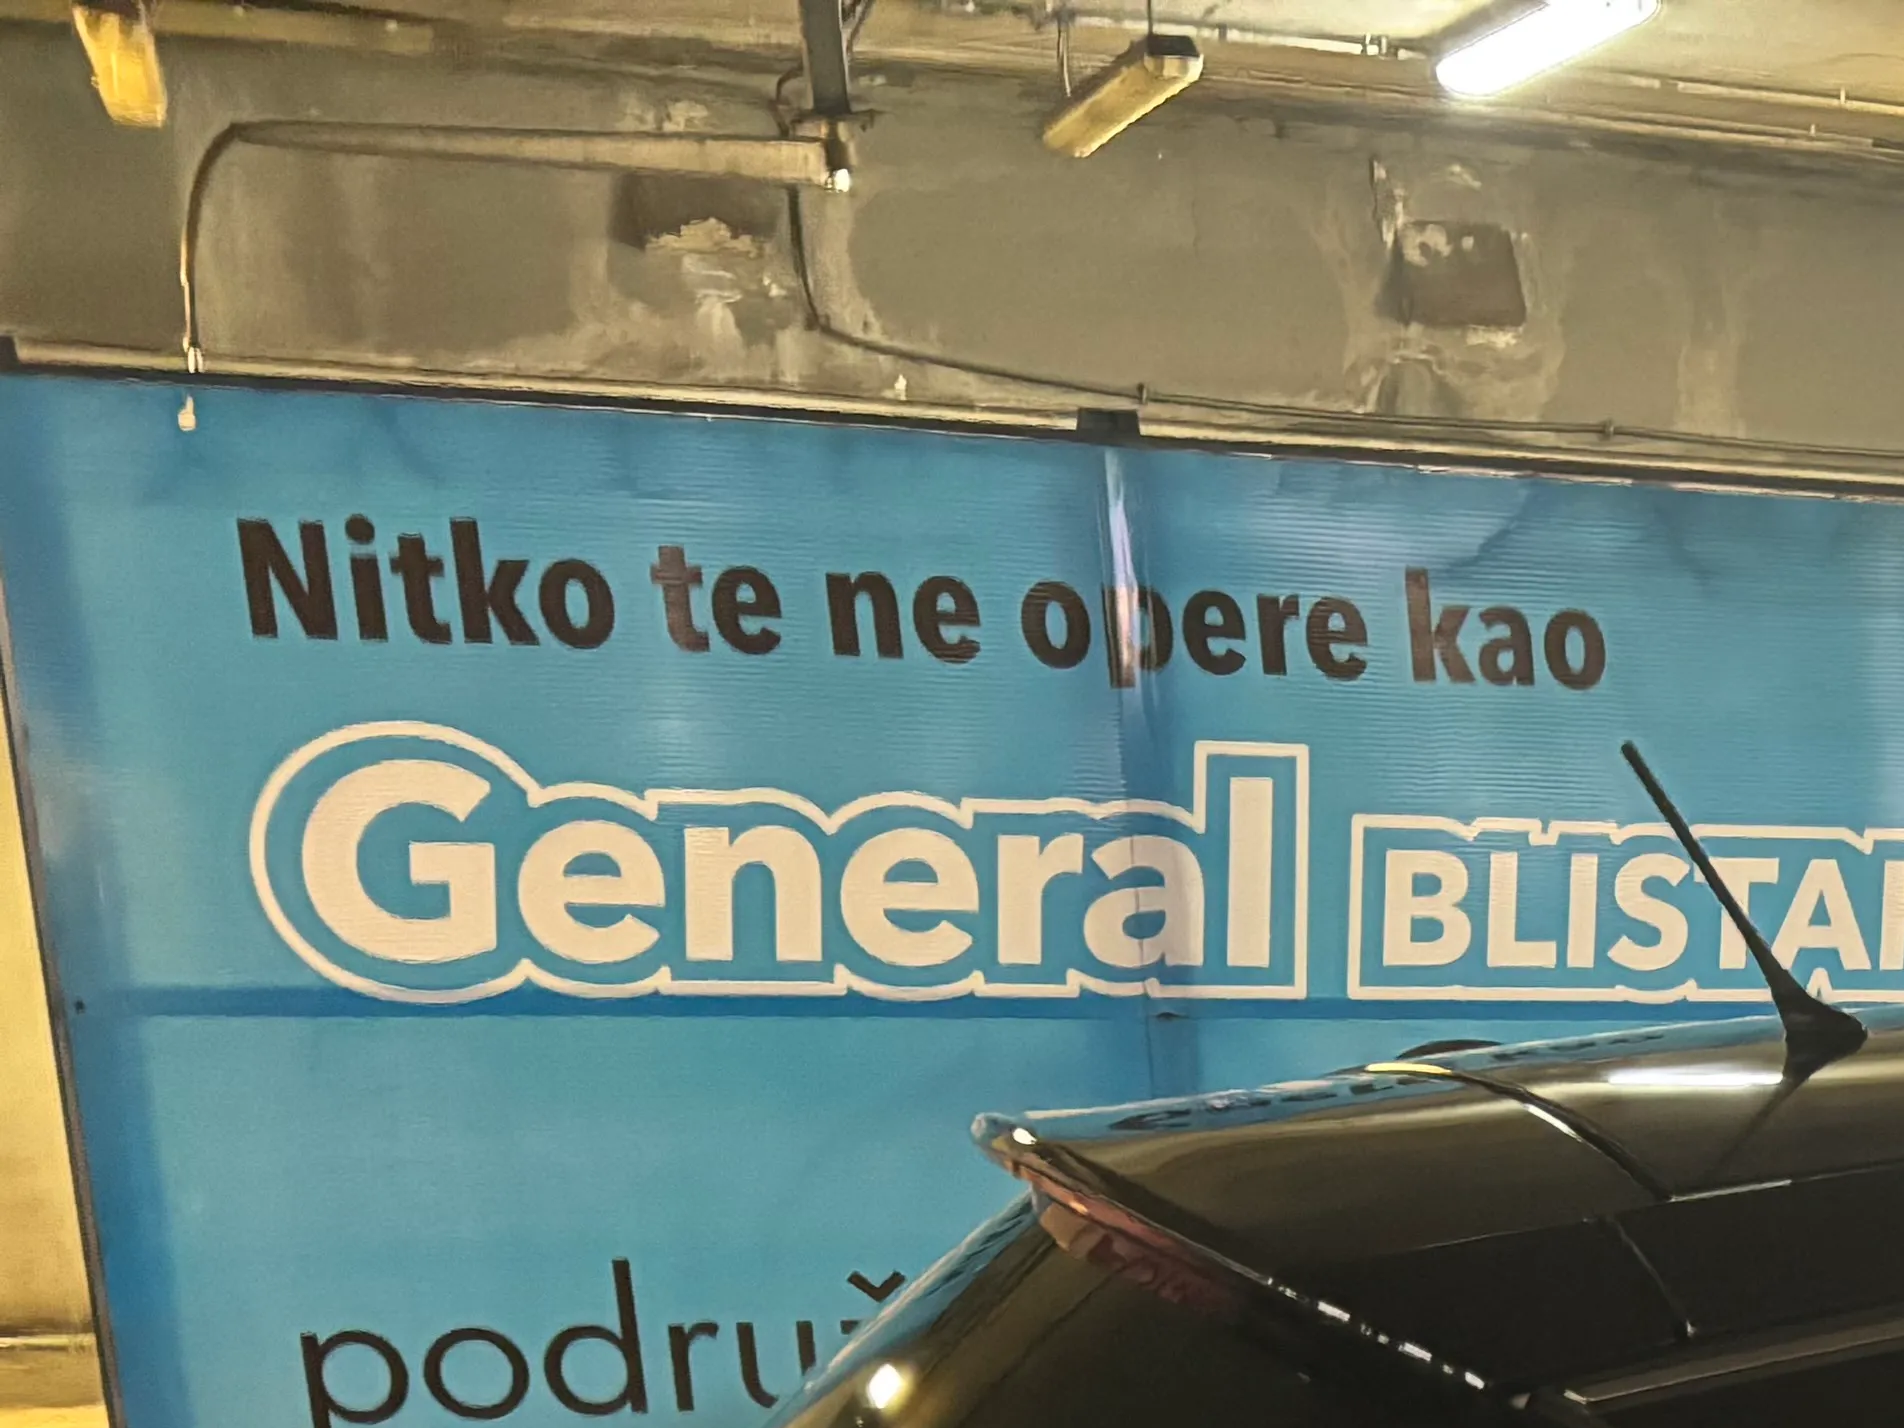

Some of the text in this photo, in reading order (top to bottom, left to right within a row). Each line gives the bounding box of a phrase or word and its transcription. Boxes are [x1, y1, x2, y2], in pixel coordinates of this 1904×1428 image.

[237, 513, 1606, 690] Nitko te ne opere kao
[302, 758, 1274, 969] General
